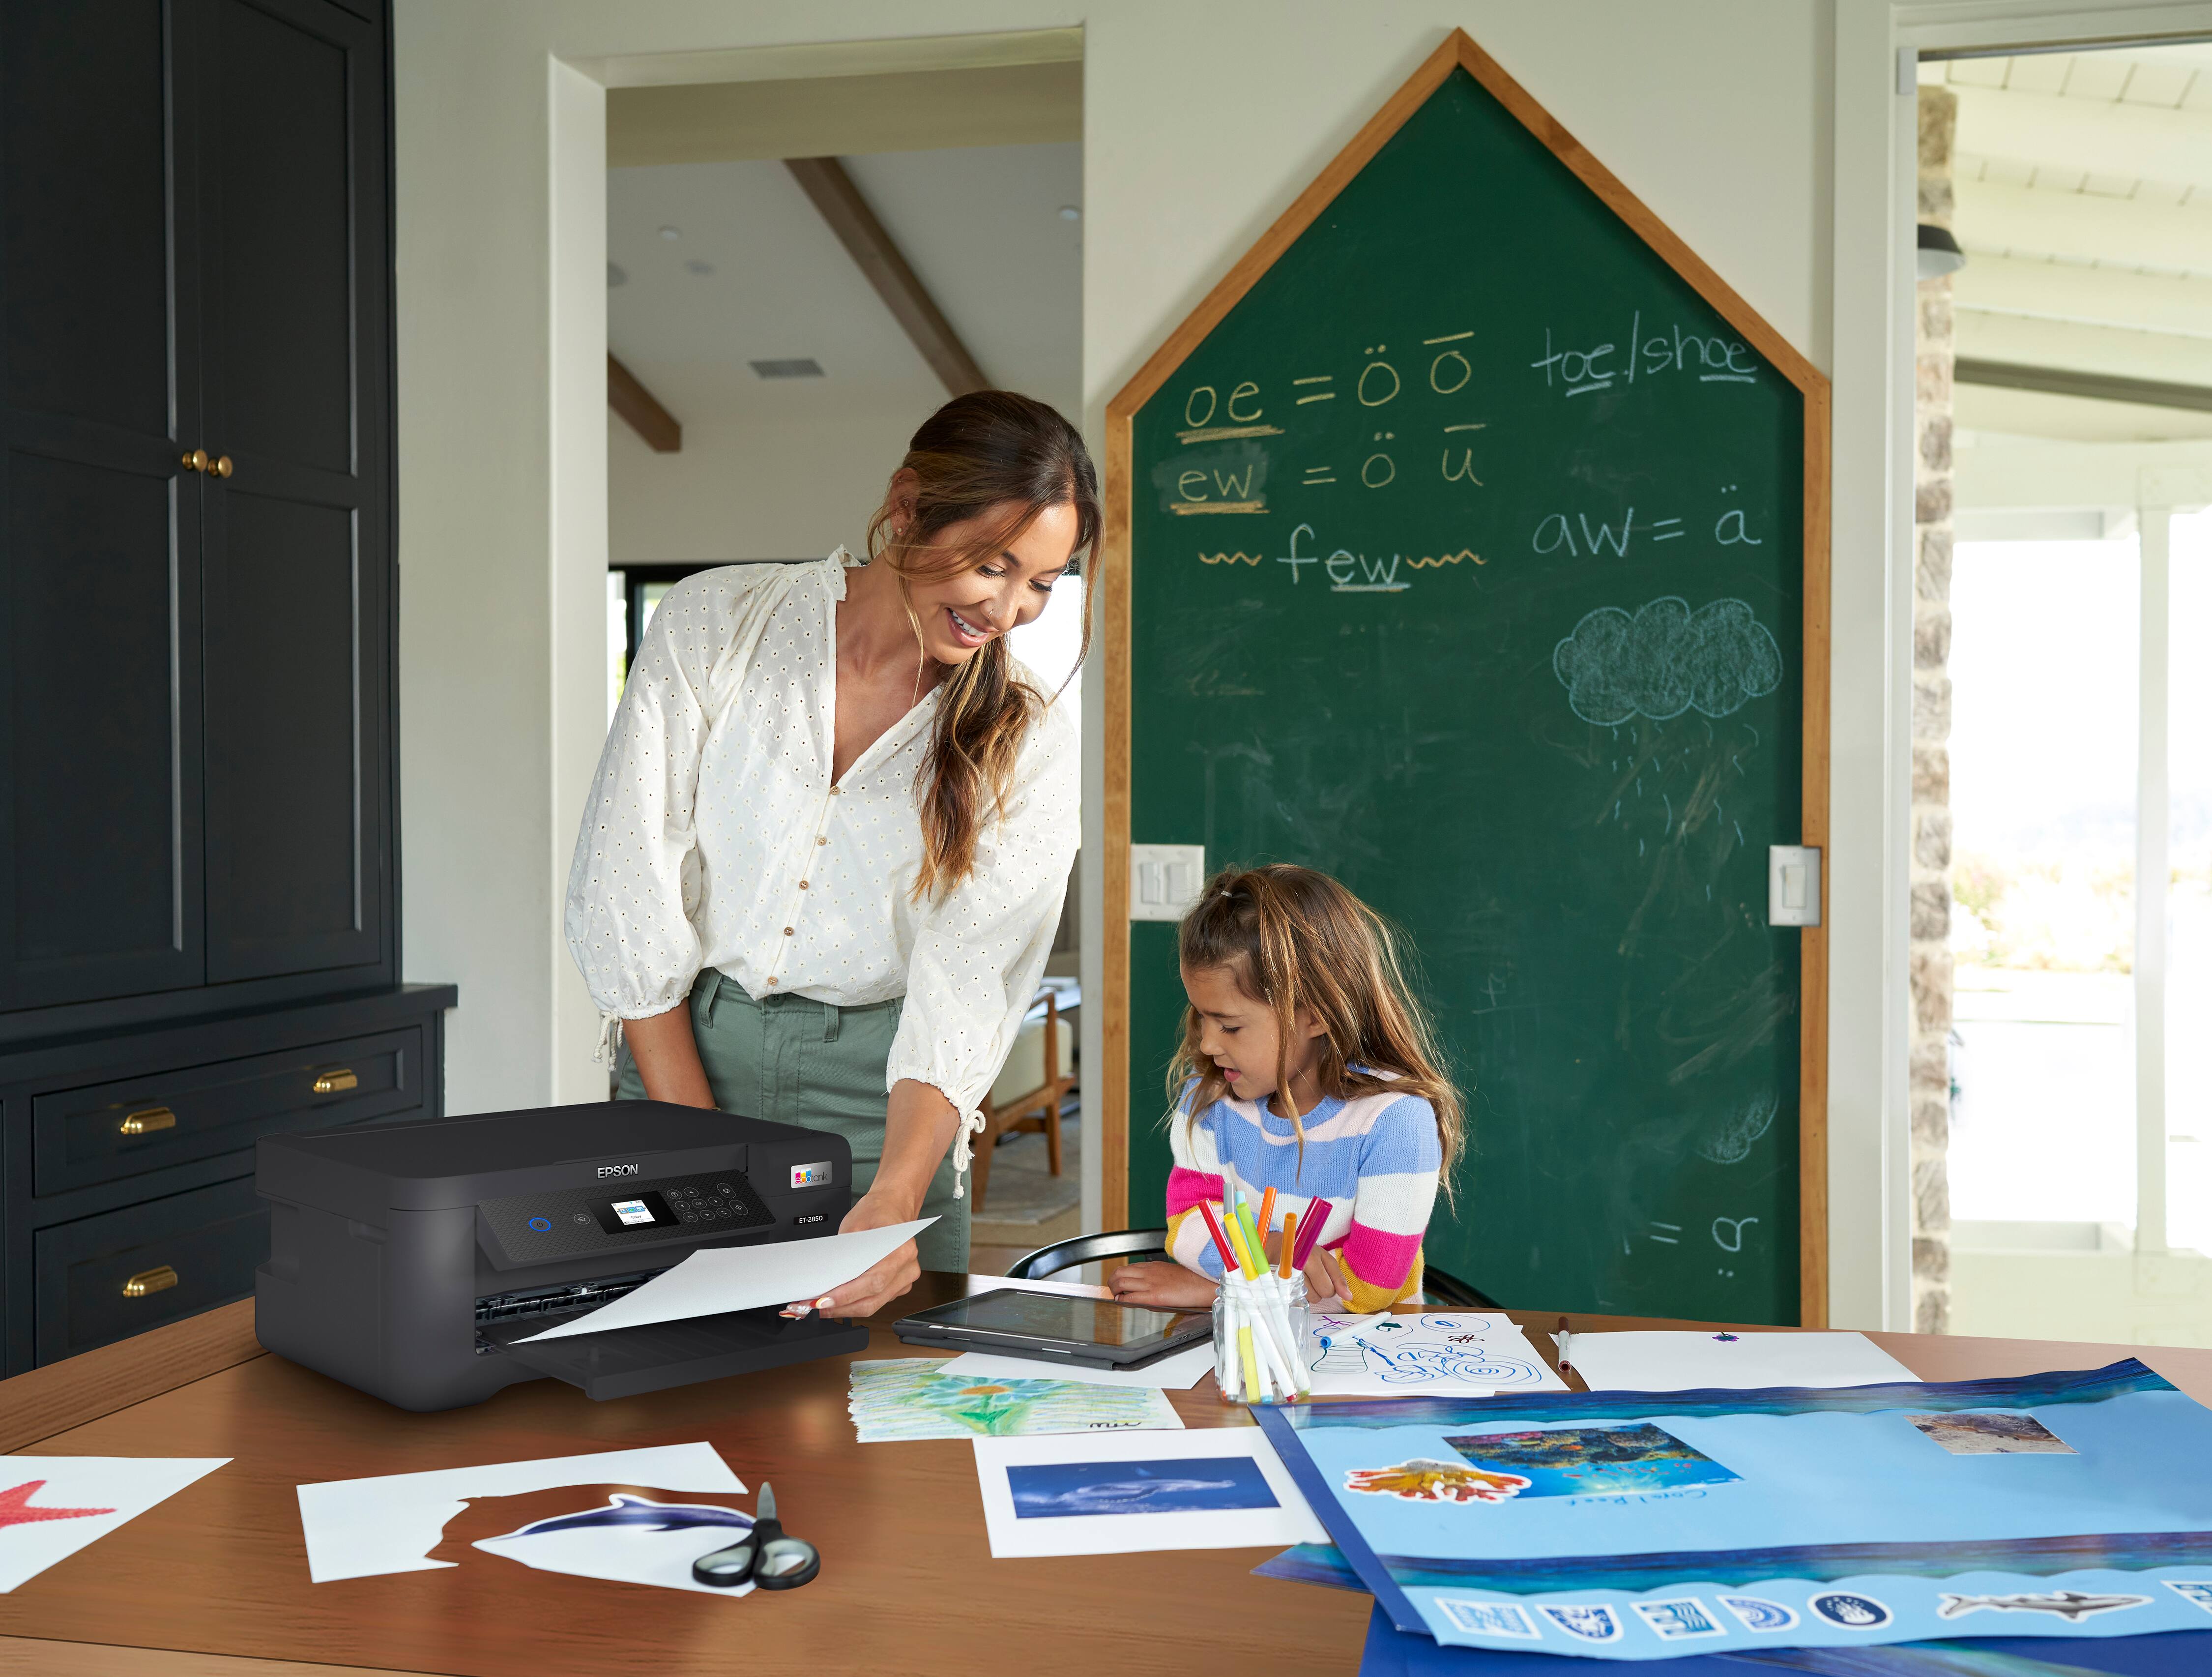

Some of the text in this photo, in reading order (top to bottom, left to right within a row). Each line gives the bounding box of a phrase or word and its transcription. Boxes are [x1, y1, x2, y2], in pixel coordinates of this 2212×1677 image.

[1186, 381, 1263, 427] oe
[1178, 464, 1252, 502] ew
[1532, 507, 1634, 557] aw
[1276, 523, 1401, 585] few
[597, 1164, 638, 1179] EPSON
[795, 1170, 828, 1184] ecotank
[799, 1215, 823, 1224] ET-2850
